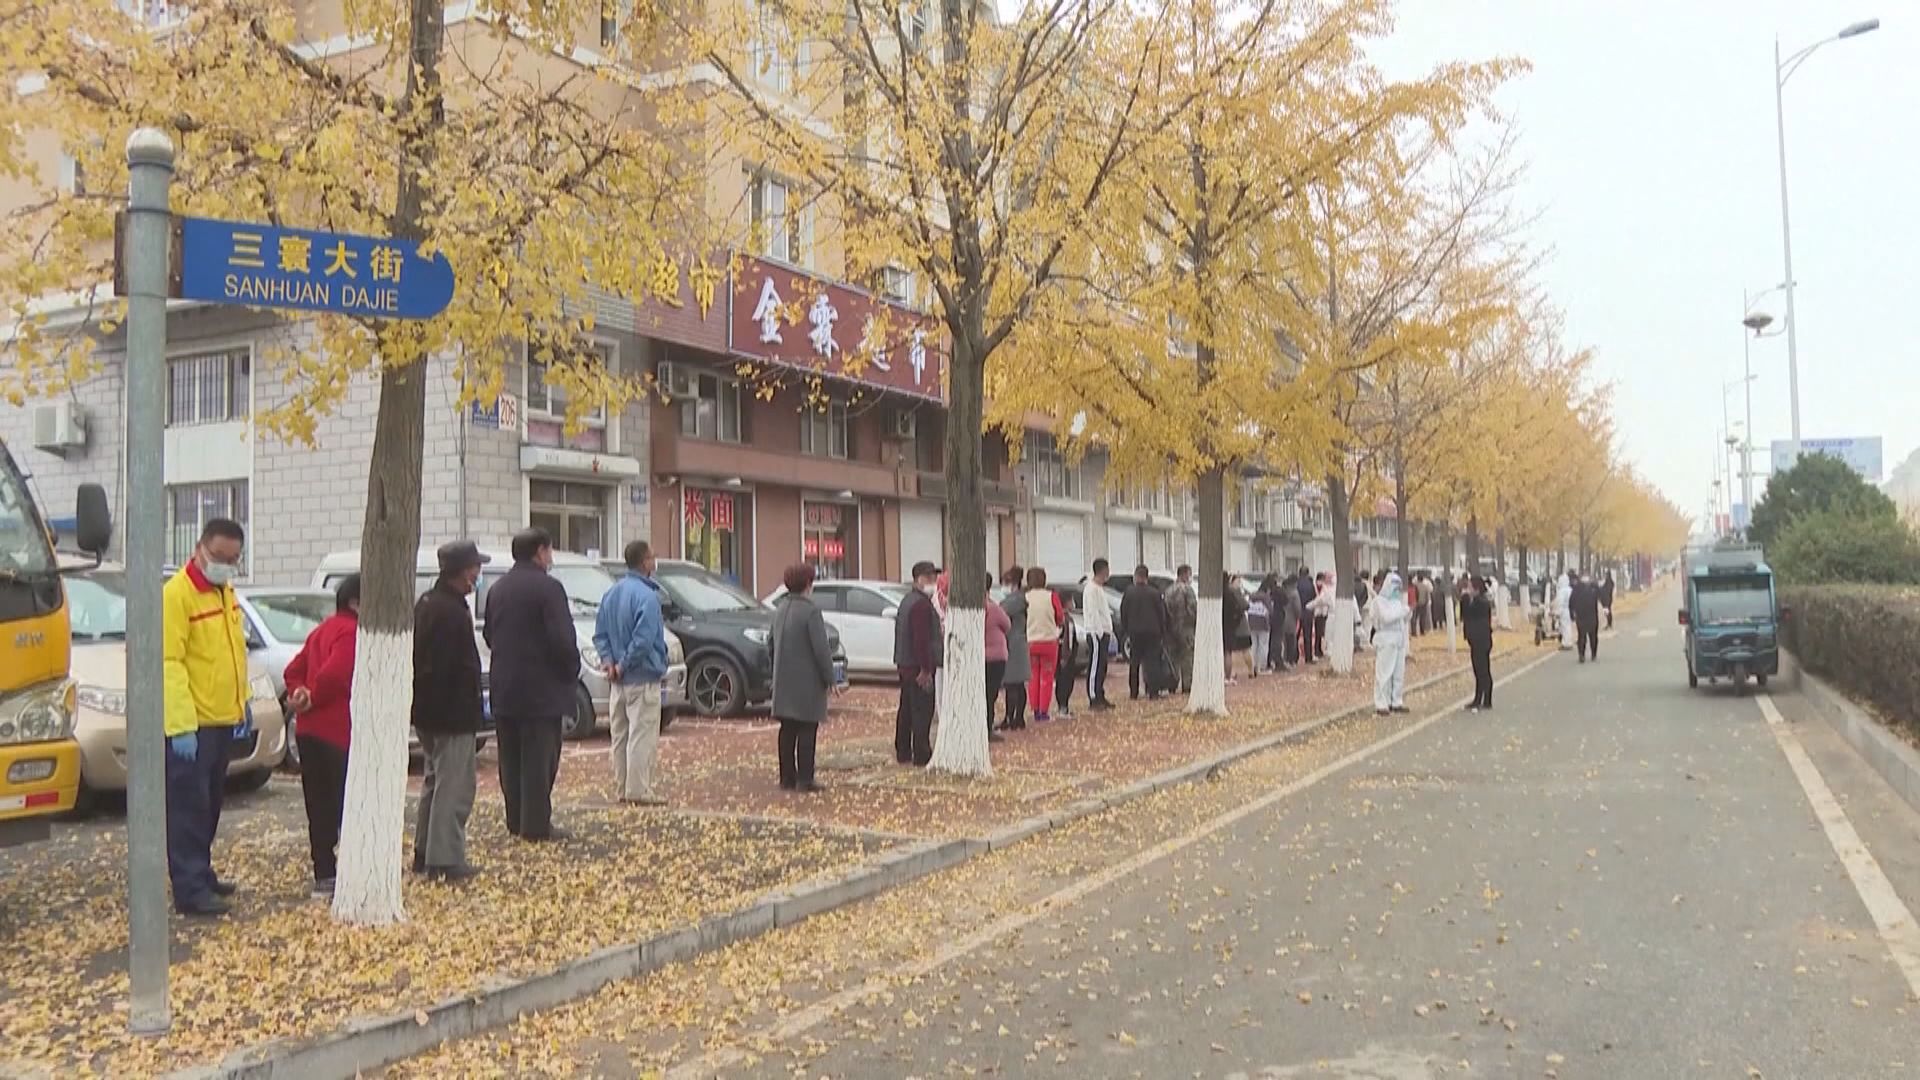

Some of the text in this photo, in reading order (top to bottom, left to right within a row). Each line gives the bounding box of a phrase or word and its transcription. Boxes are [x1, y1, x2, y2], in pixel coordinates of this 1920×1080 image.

[228, 231, 404, 282] 三寰大街
[224, 273, 399, 311] SANHUAN DAJIE
[500, 399, 516, 426] 206
[684, 487, 734, 533] 米面
